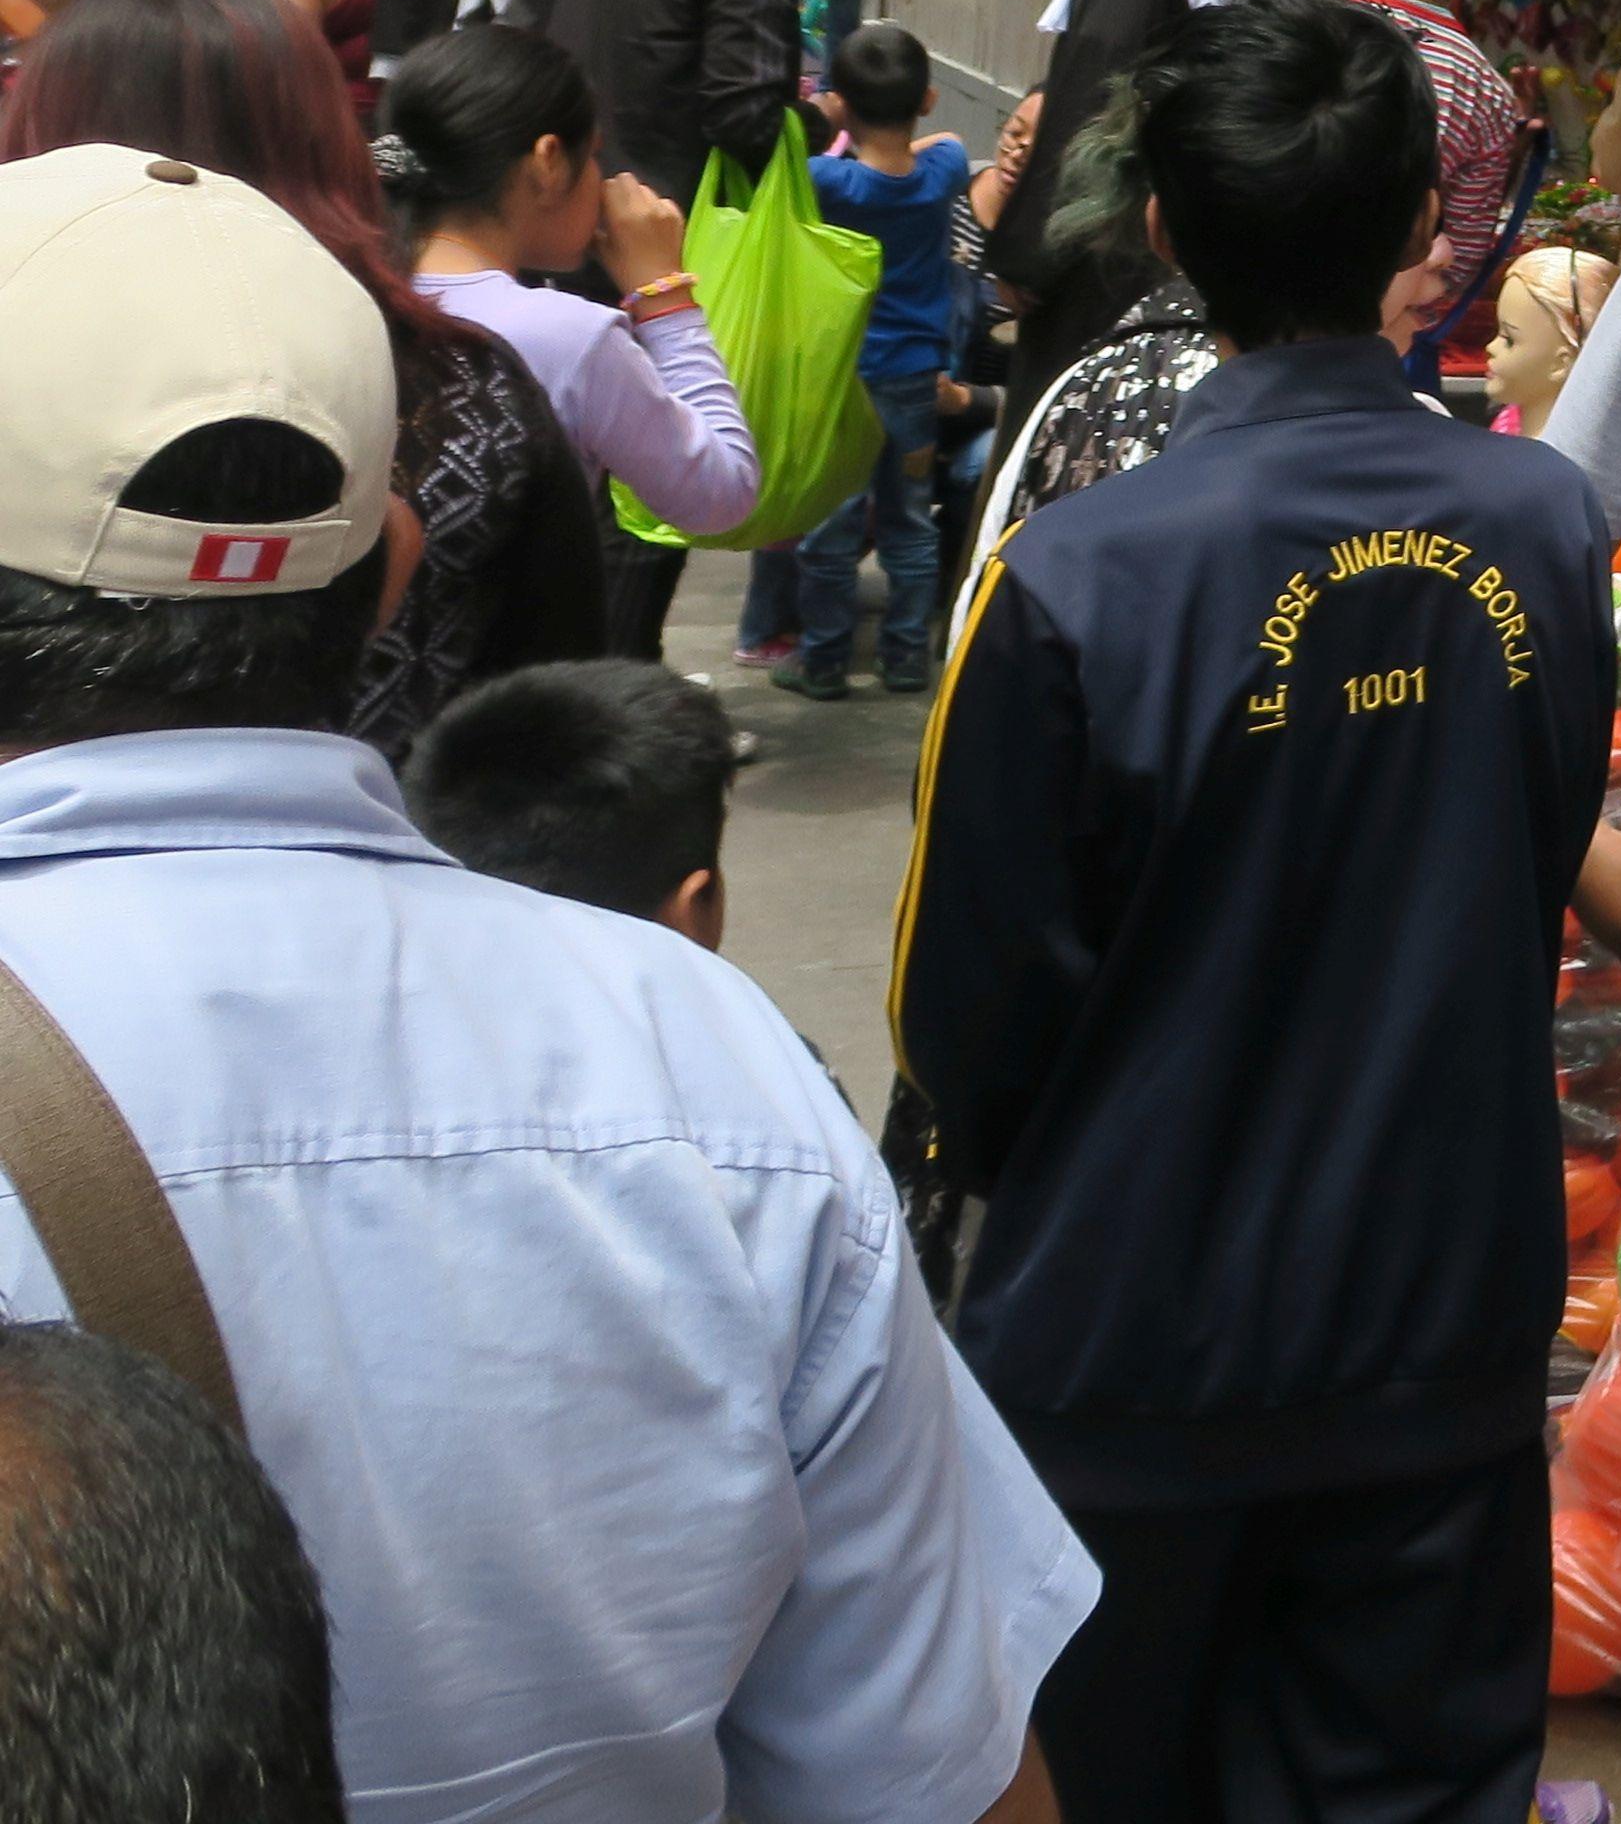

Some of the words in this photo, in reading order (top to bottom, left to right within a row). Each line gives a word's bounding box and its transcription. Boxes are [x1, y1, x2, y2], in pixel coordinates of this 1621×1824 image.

[1259, 571, 1320, 667] JOSE
[1329, 529, 1473, 582] JIMENEZ
[1468, 566, 1533, 690] BORJA
[1344, 666, 1427, 714] 1001
